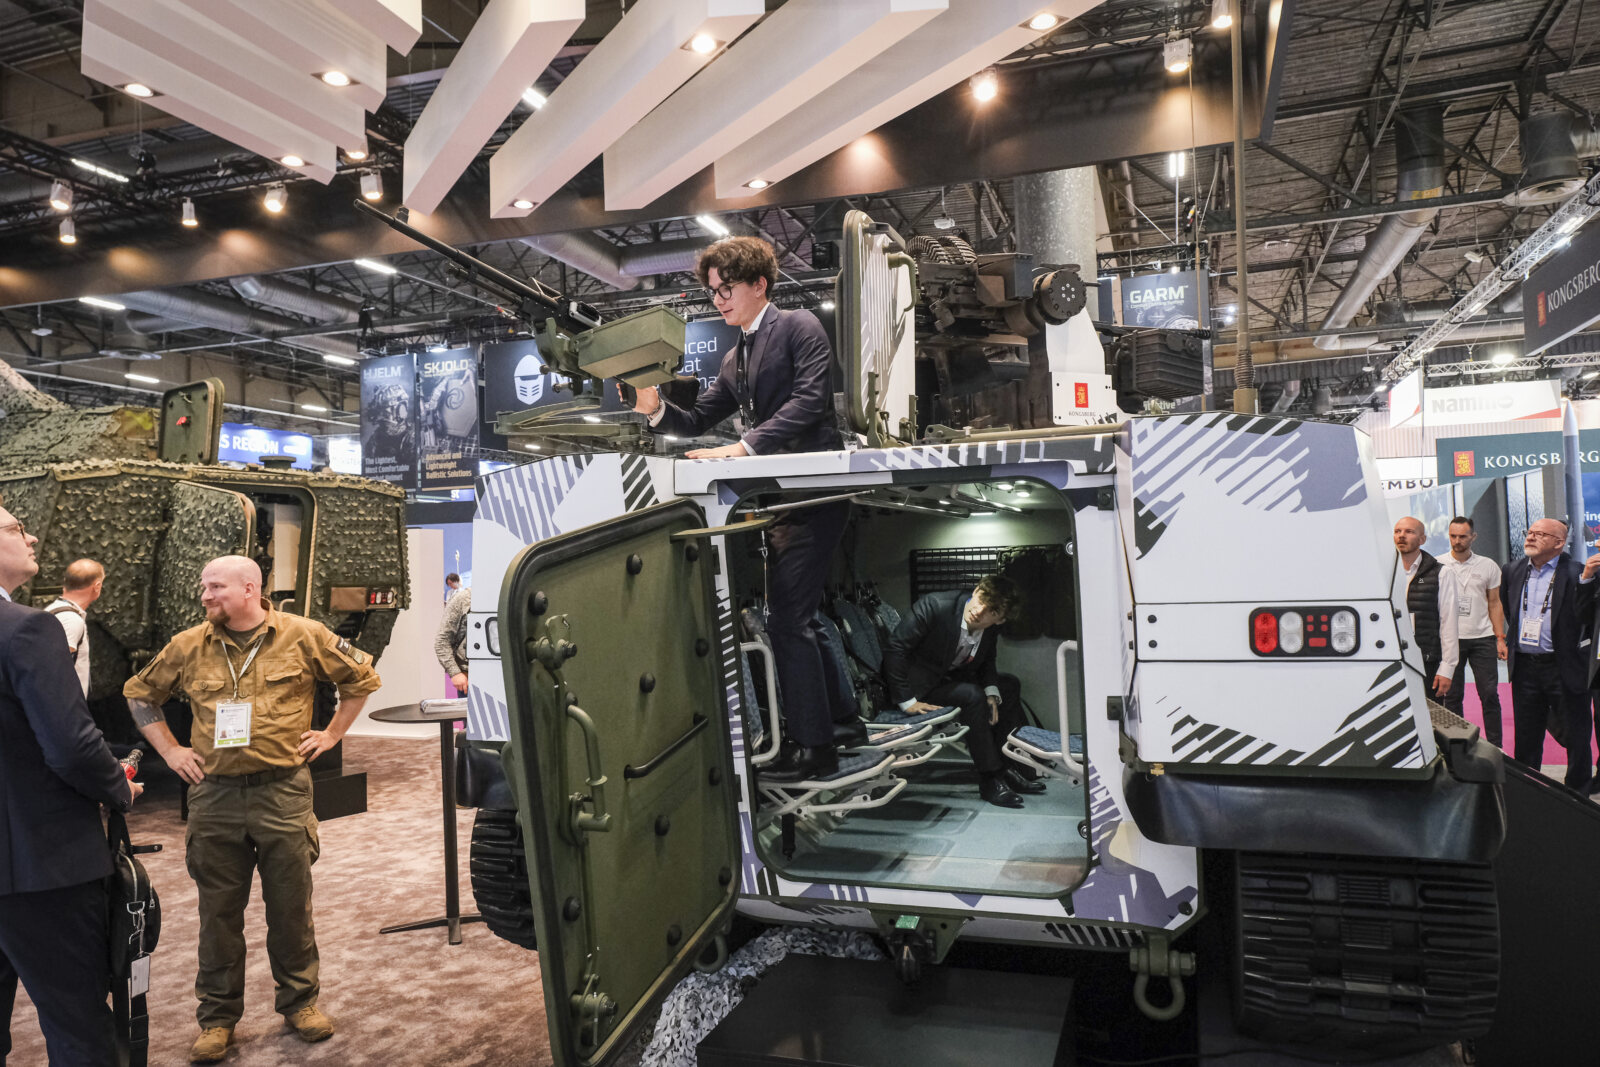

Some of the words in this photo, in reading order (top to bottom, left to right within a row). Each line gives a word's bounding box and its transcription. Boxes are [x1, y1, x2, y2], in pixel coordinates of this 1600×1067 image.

[1130, 286, 1185, 304] GARM
[363, 366, 402, 379] HJELM
[424, 359, 468, 375] SKJOLD
[1484, 450, 1600, 468] KONGSBRG
